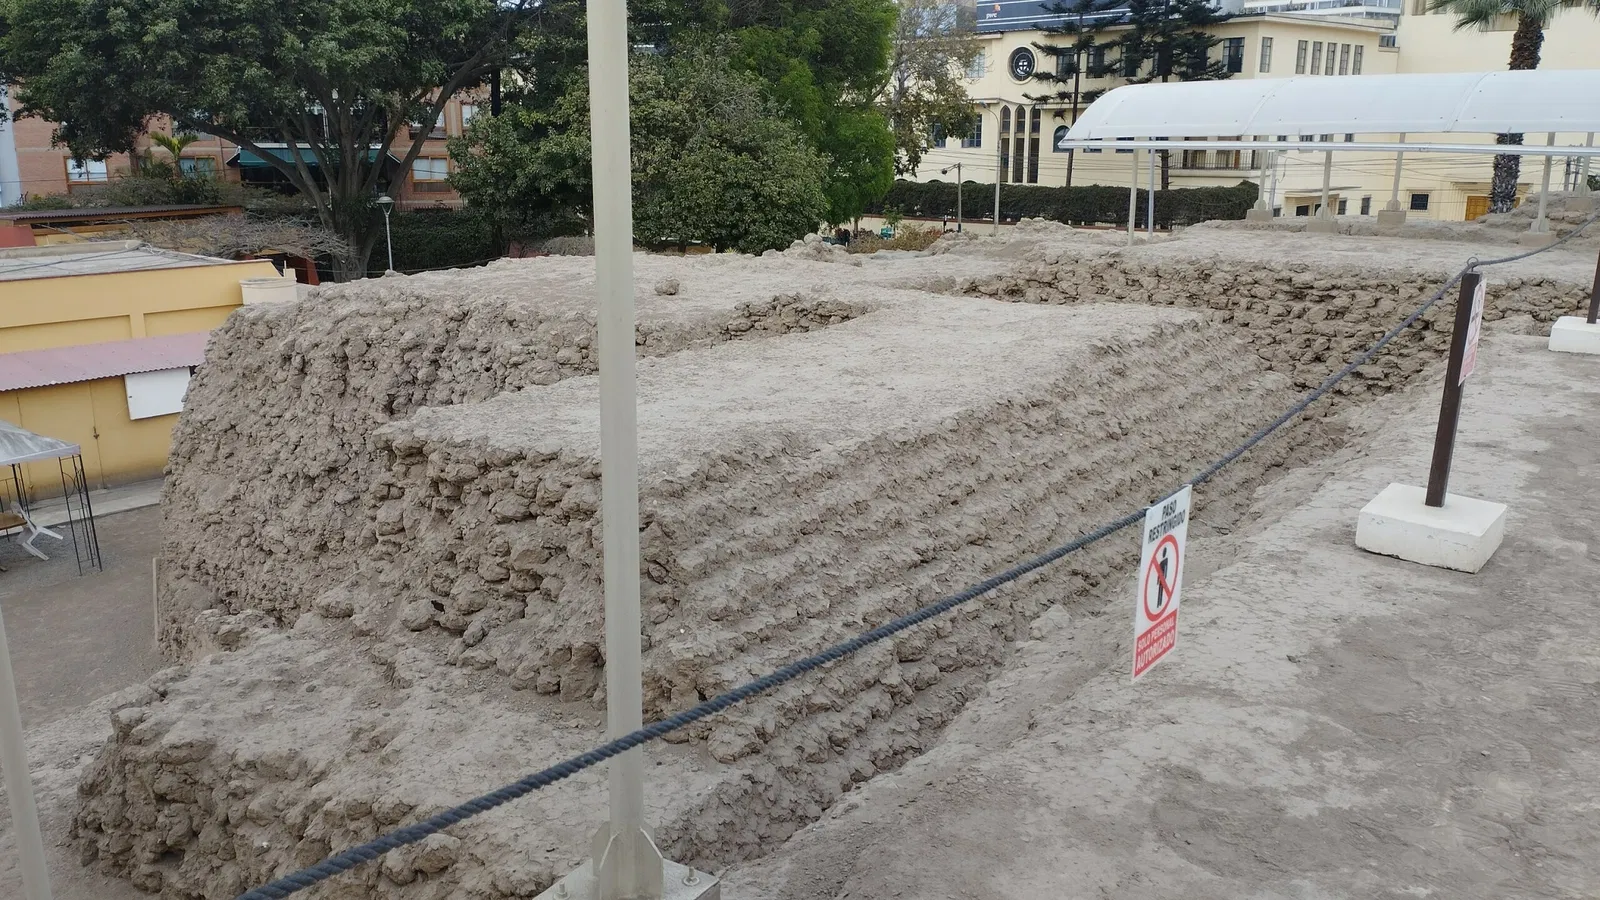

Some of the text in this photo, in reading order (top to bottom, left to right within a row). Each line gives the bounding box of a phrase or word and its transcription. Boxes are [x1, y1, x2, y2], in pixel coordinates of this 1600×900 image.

[1162, 500, 1177, 520] PASO
[1148, 509, 1186, 544] RESTRINGIDO
[1135, 629, 1175, 672] AUTORIZADO
[1138, 633, 1151, 652] SOLO
